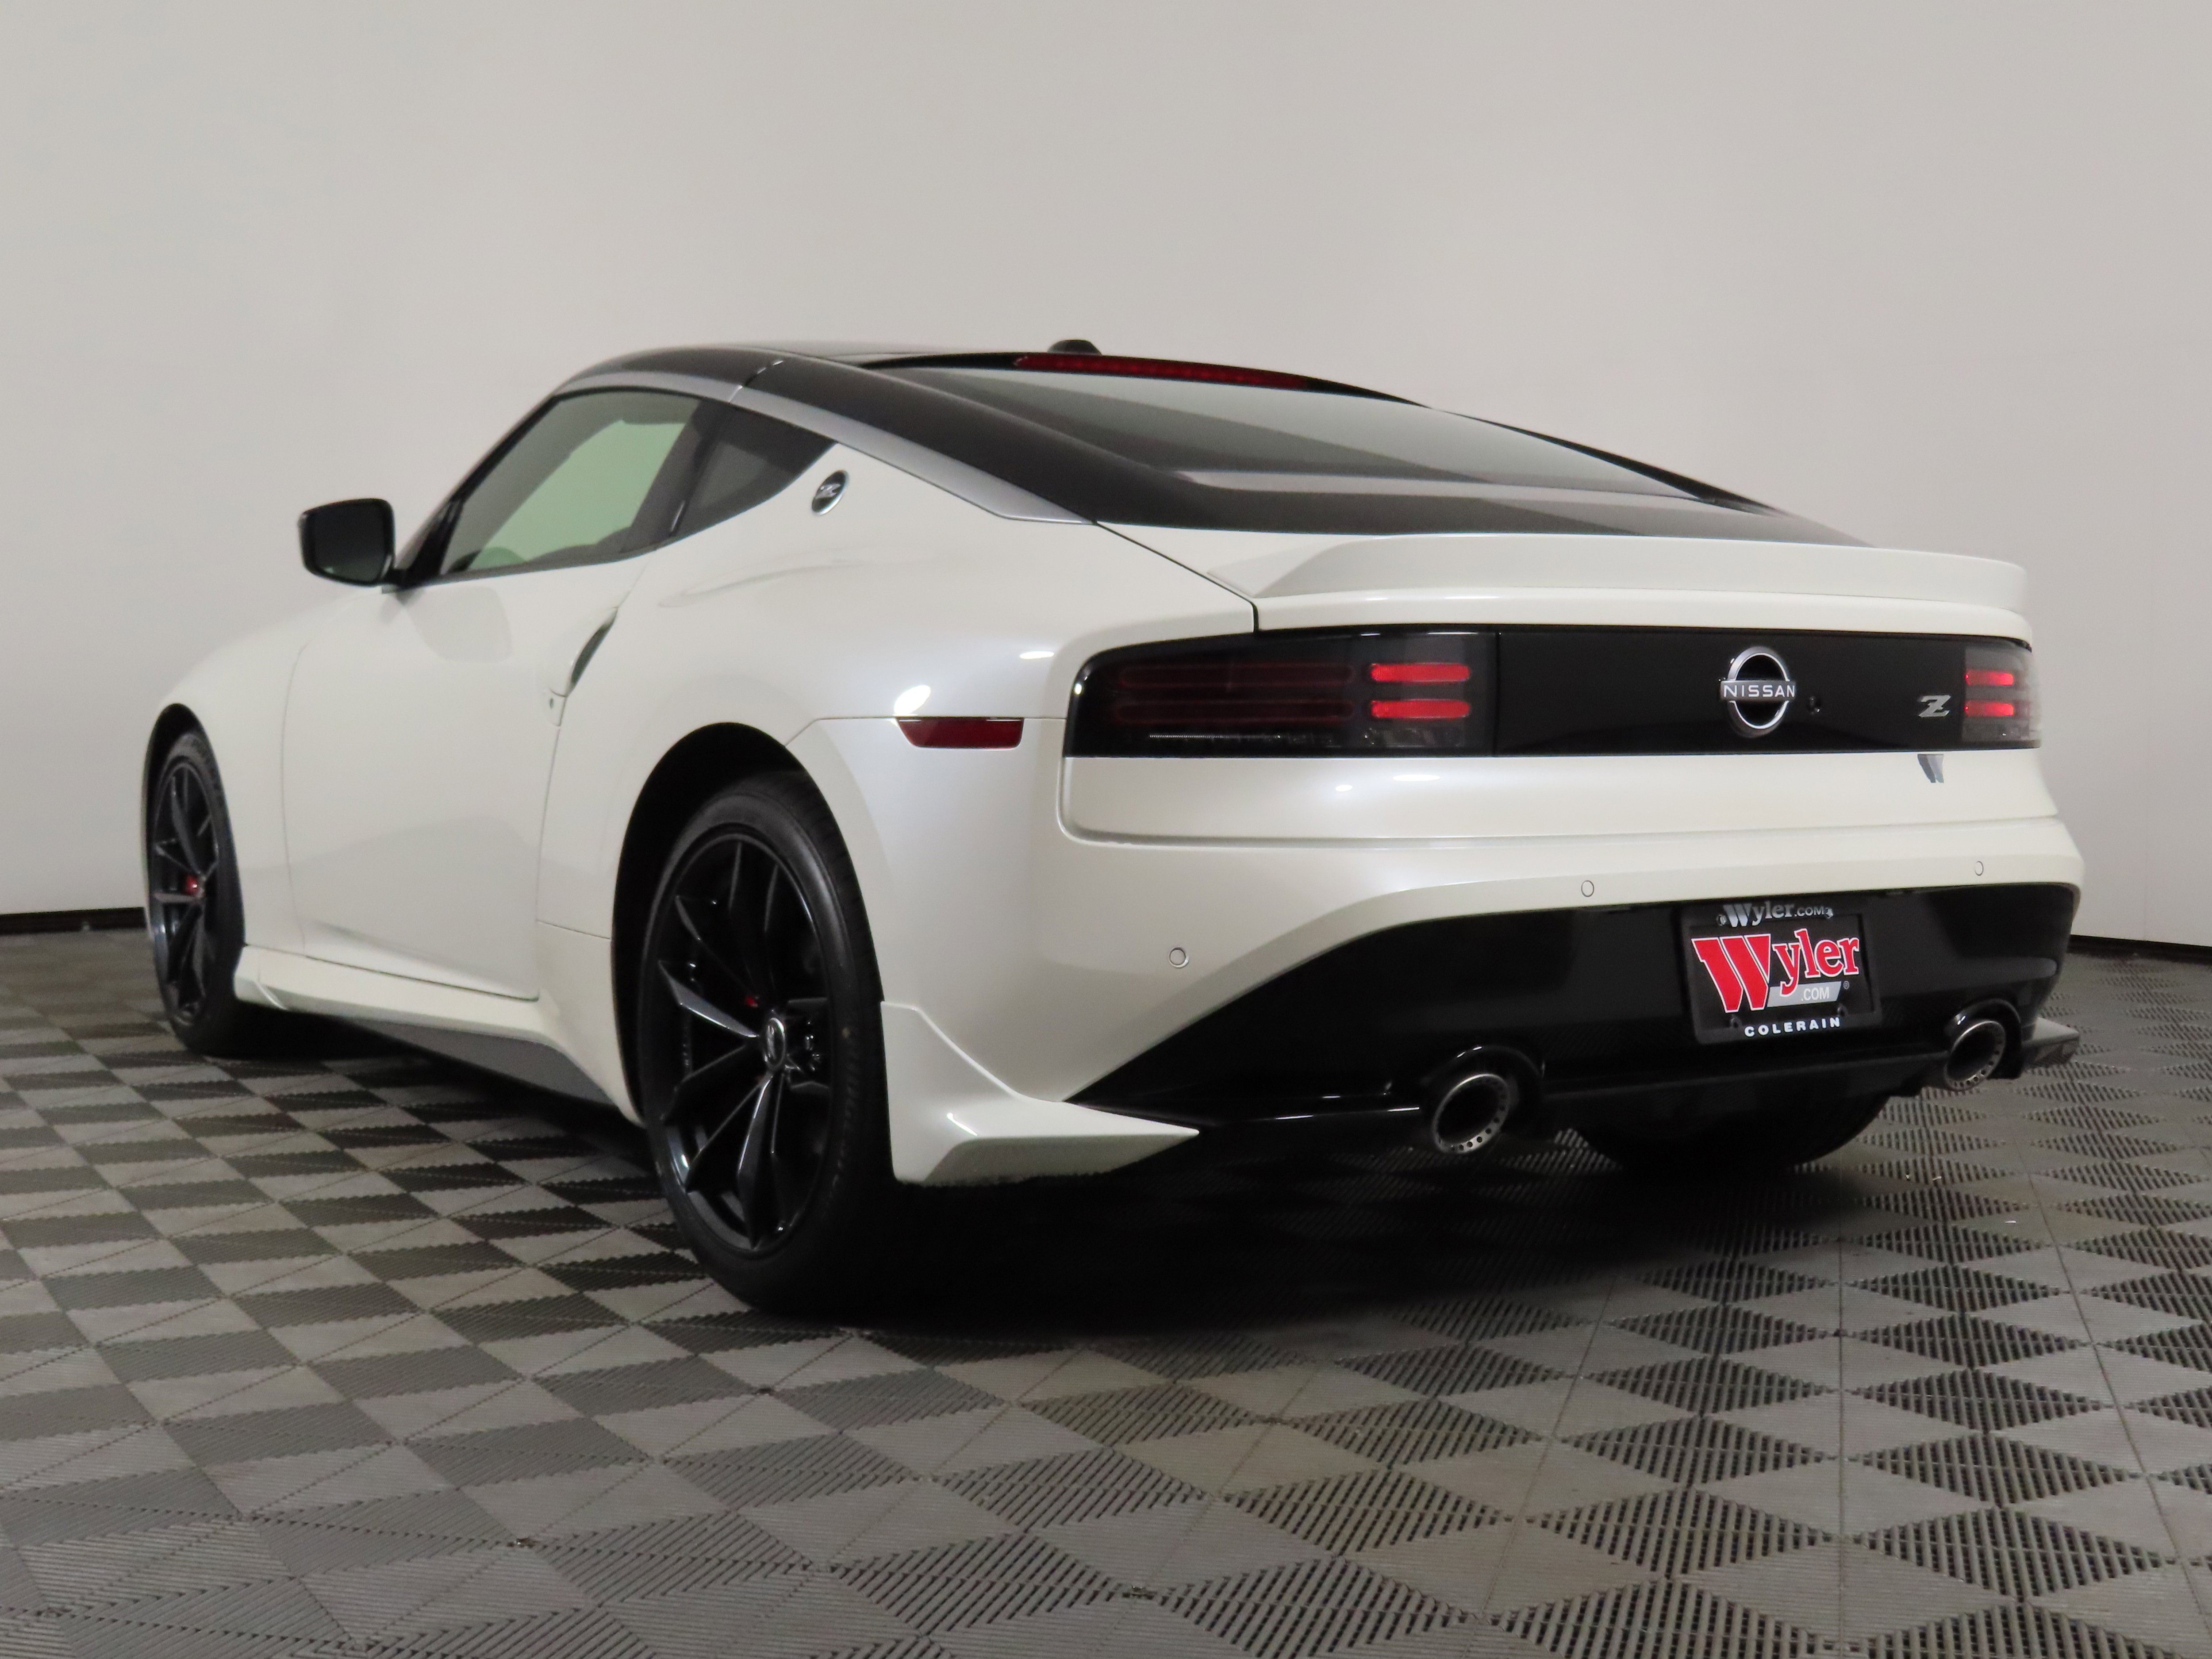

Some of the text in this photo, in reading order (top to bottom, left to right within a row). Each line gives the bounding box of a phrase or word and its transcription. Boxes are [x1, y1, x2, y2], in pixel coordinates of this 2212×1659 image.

[1724, 684, 1795, 698] NISSAN
[1917, 695, 1951, 718] Z
[1691, 928, 1859, 1013] Wyler
[1744, 1017, 1841, 1037] COLERAIN
